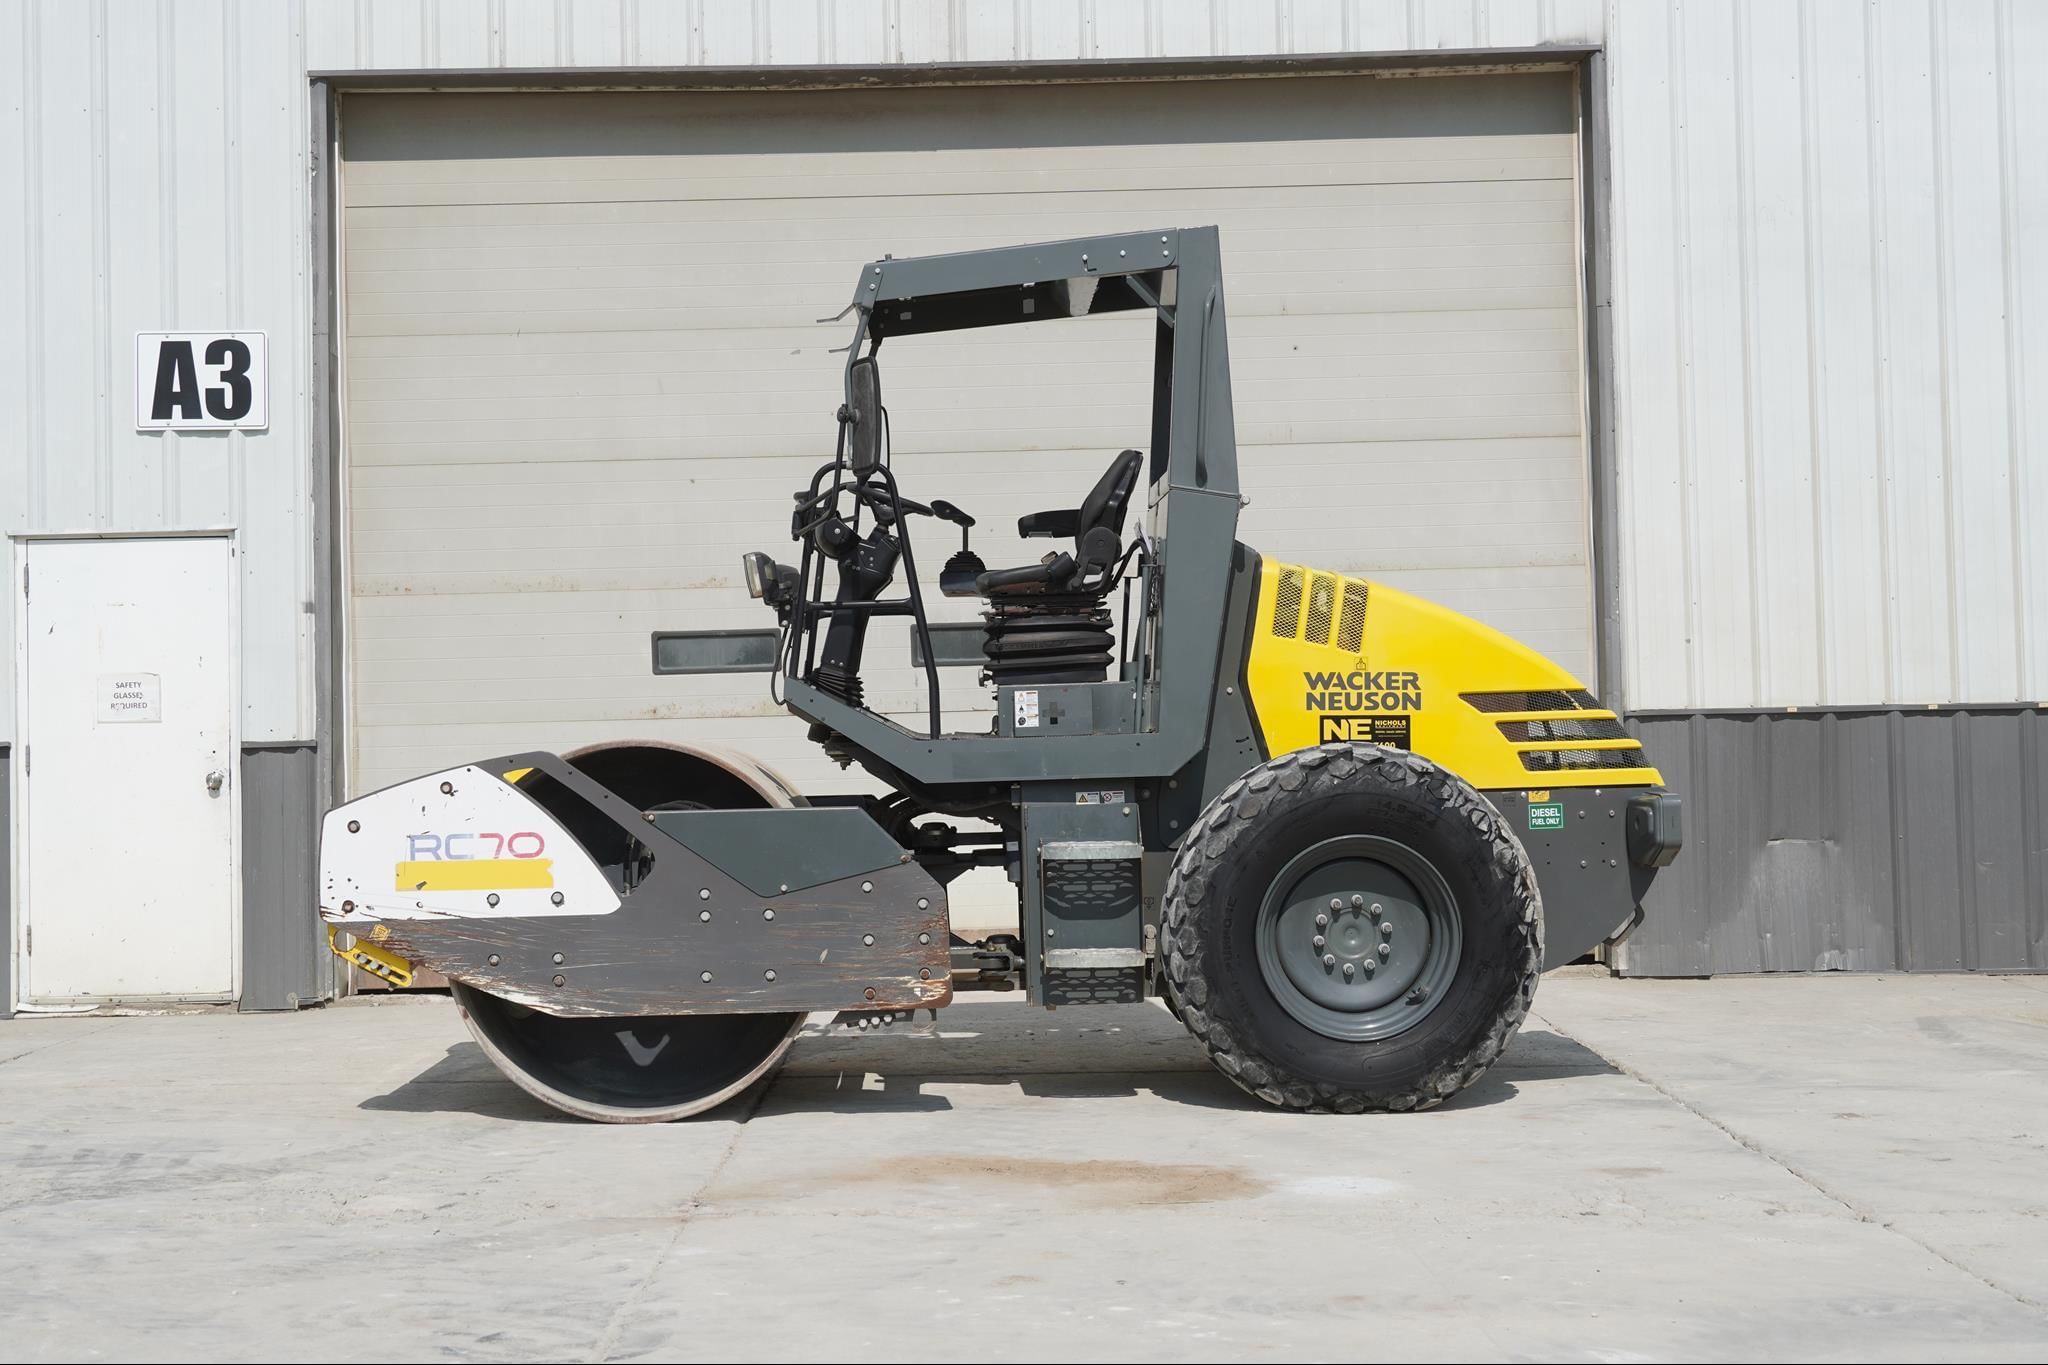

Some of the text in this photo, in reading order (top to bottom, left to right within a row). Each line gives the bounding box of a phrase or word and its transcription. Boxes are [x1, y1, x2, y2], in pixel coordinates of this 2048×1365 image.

[151, 339, 252, 420] A3
[115, 681, 142, 689] SAFETY
[1303, 672, 1421, 690] WACKER
[1306, 692, 1421, 710] NEUSON
[1323, 719, 1372, 740] NE
[1531, 808, 1560, 817] DIESEL
[409, 832, 545, 861] RC70
